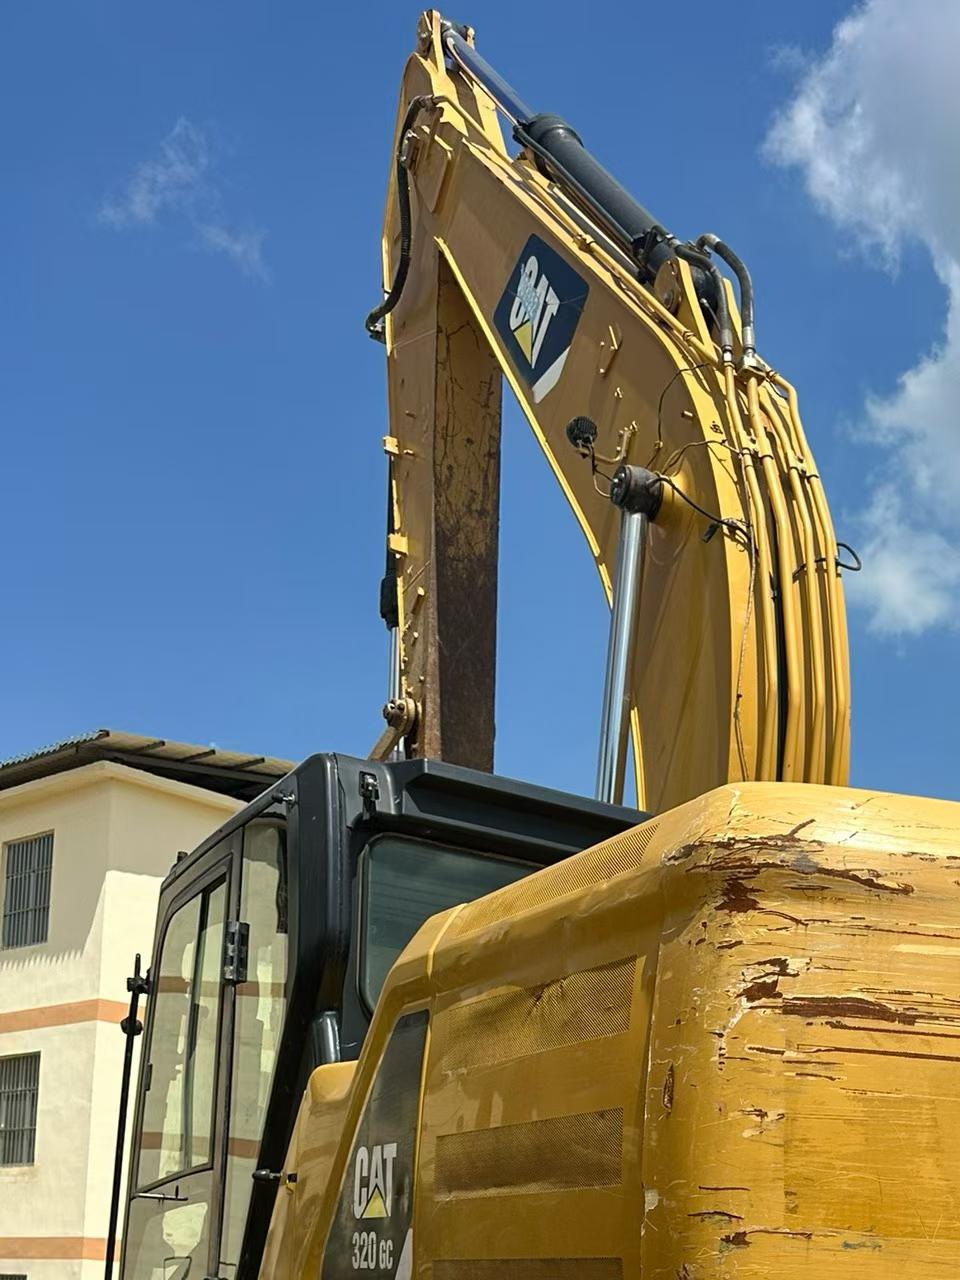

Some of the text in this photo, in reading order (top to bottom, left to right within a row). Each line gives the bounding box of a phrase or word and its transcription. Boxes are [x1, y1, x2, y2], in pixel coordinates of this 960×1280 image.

[510, 256, 560, 369] CAT
[353, 1142, 398, 1219] CAT
[352, 1231, 393, 1270] 320 GC
